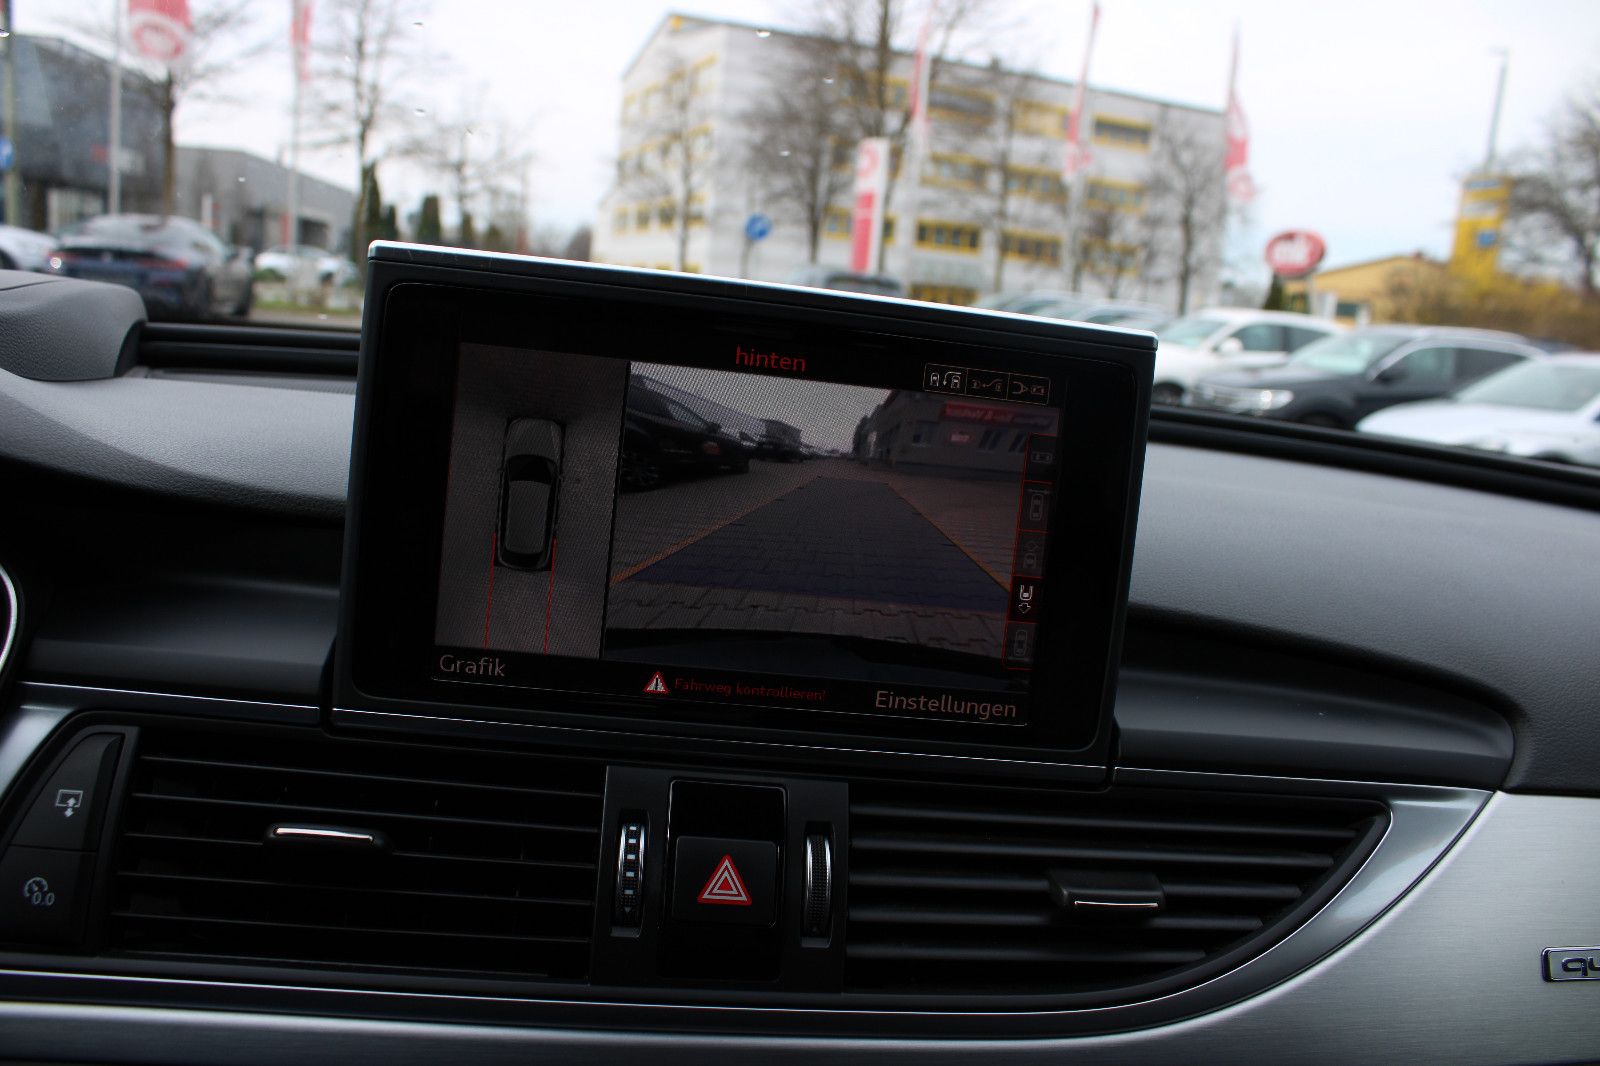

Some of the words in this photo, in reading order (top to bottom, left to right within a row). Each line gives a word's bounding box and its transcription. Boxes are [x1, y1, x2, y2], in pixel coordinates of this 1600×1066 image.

[735, 344, 807, 372] hinten
[439, 654, 506, 677] Grafik
[675, 678, 732, 696] Fahrweg
[736, 682, 826, 701] kontrollieren!
[875, 690, 1017, 720] Einstellungen
